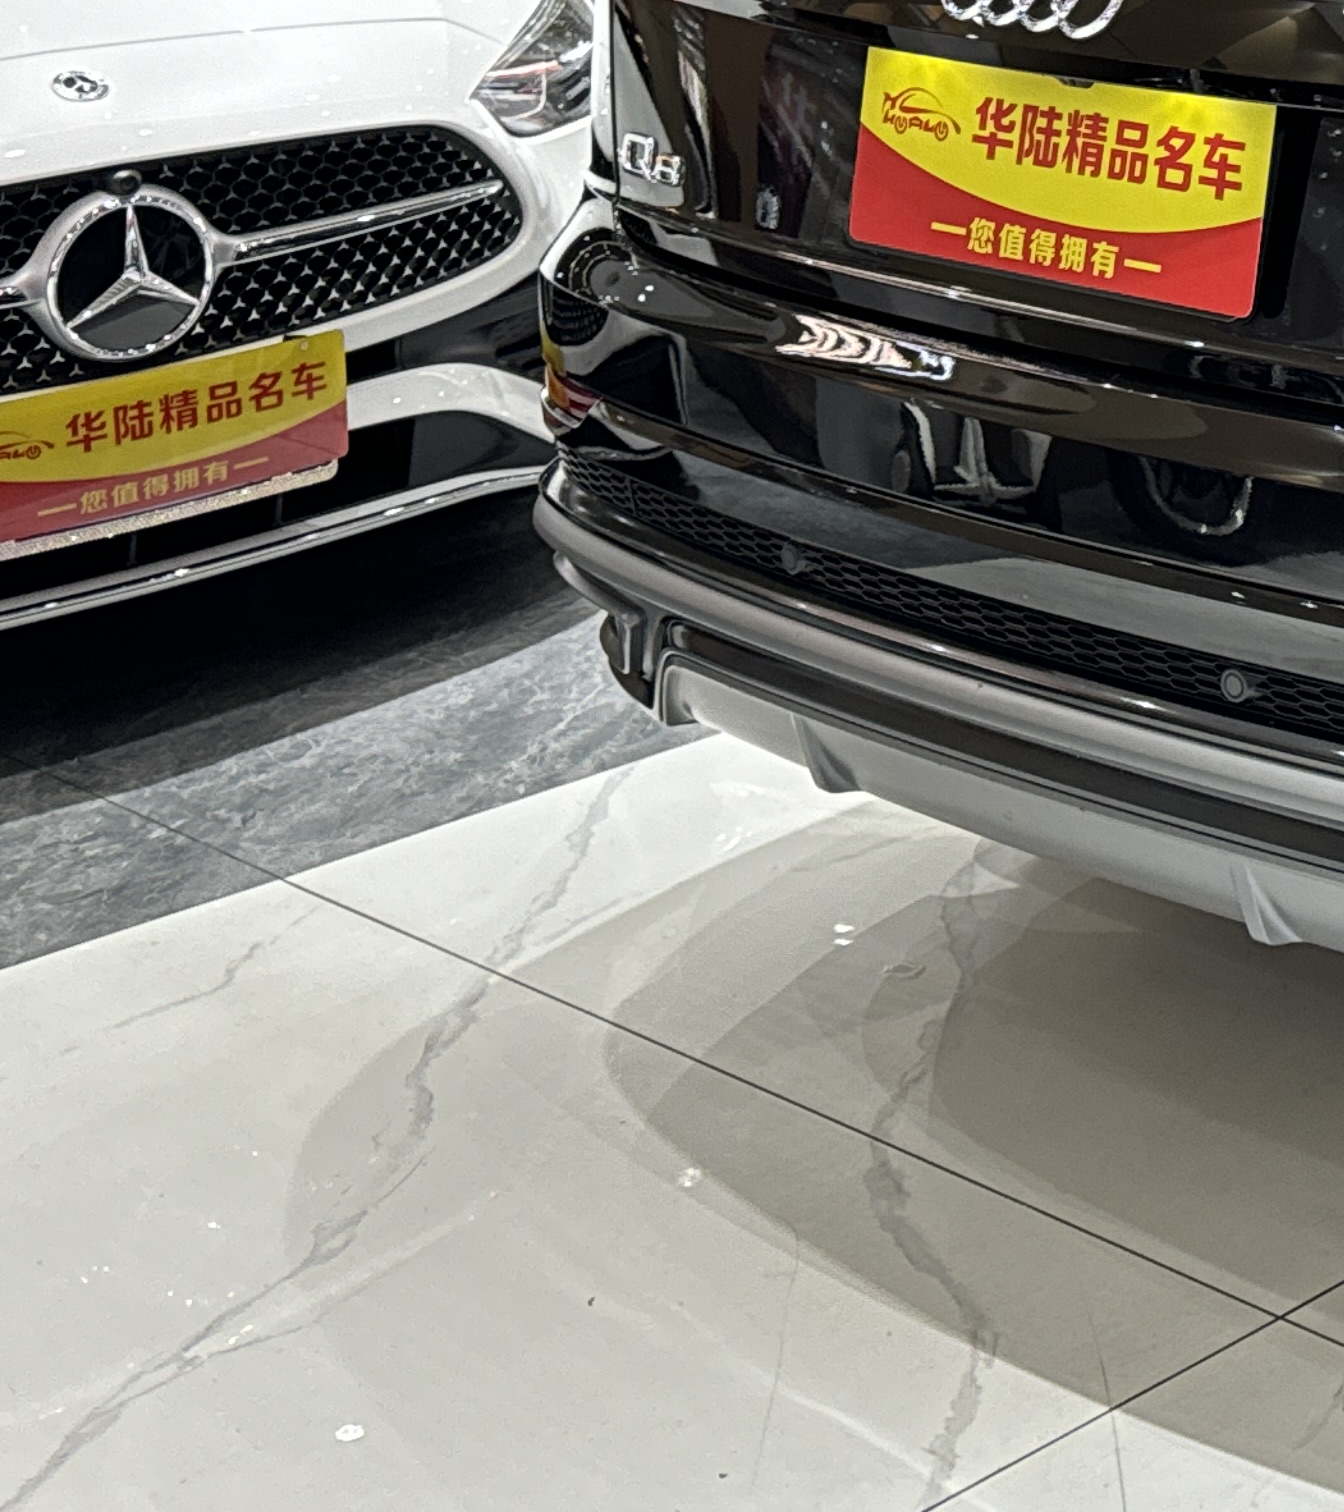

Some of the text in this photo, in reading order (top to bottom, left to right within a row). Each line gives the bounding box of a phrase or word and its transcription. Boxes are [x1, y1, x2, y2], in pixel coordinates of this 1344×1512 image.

[617, 133, 684, 186] Q8
[972, 96, 1246, 201] 华陆精品名车
[65, 361, 327, 453] 华陆精品名车
